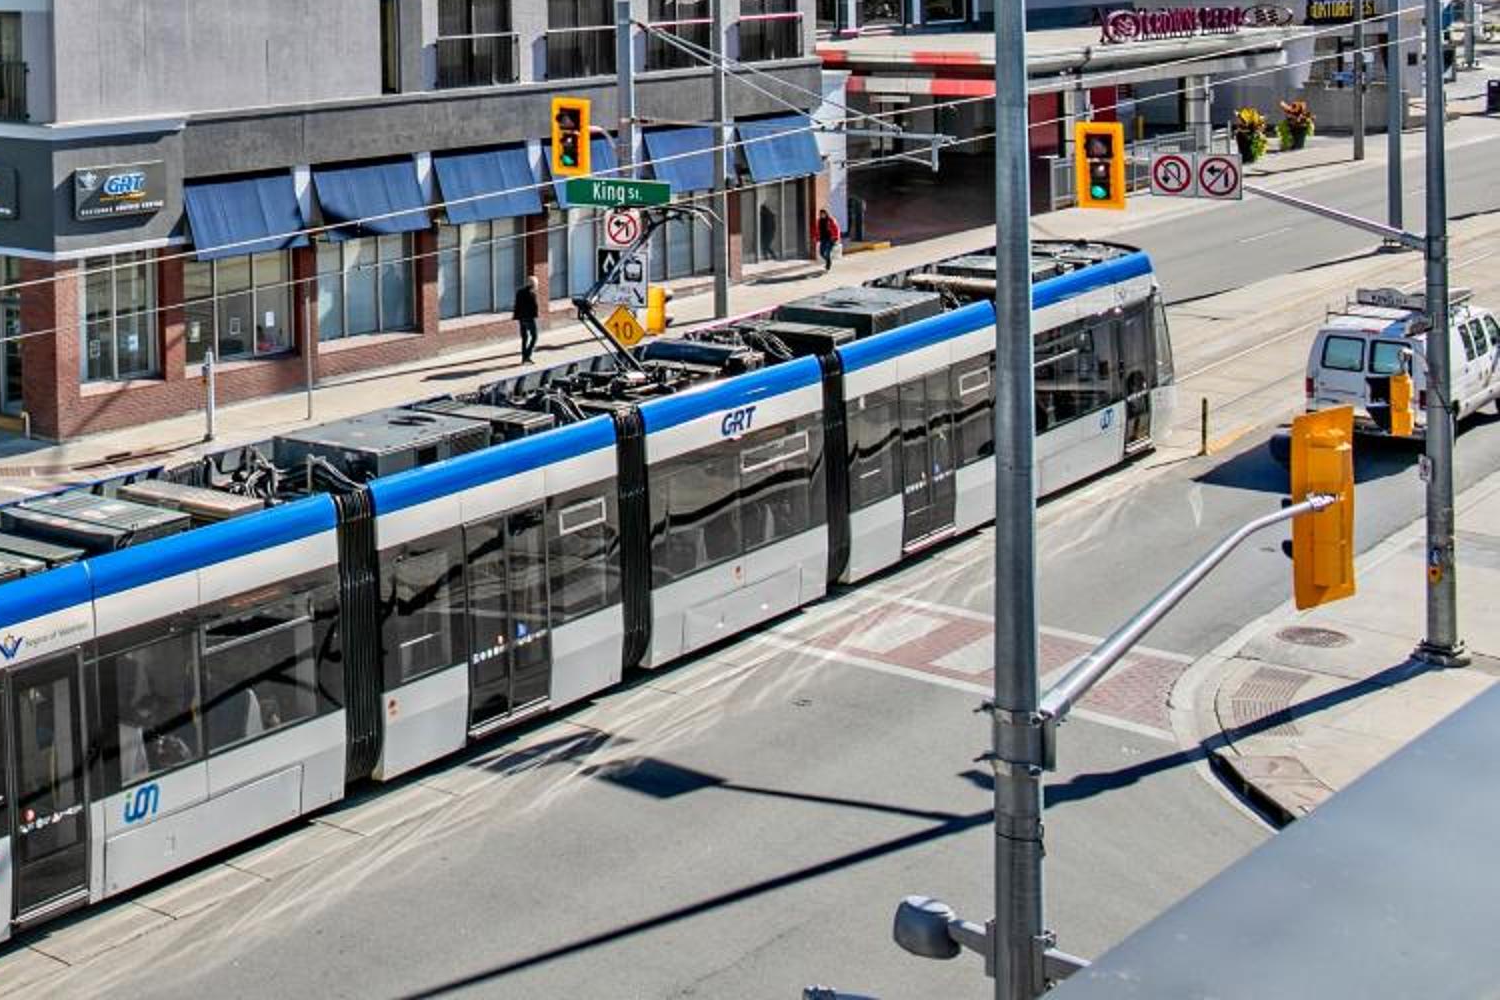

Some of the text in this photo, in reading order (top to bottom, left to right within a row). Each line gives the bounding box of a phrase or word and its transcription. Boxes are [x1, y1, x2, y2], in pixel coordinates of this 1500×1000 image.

[103, 171, 147, 195] GRT
[592, 181, 625, 206] King
[612, 321, 634, 341] 10
[721, 405, 757, 437] GRT
